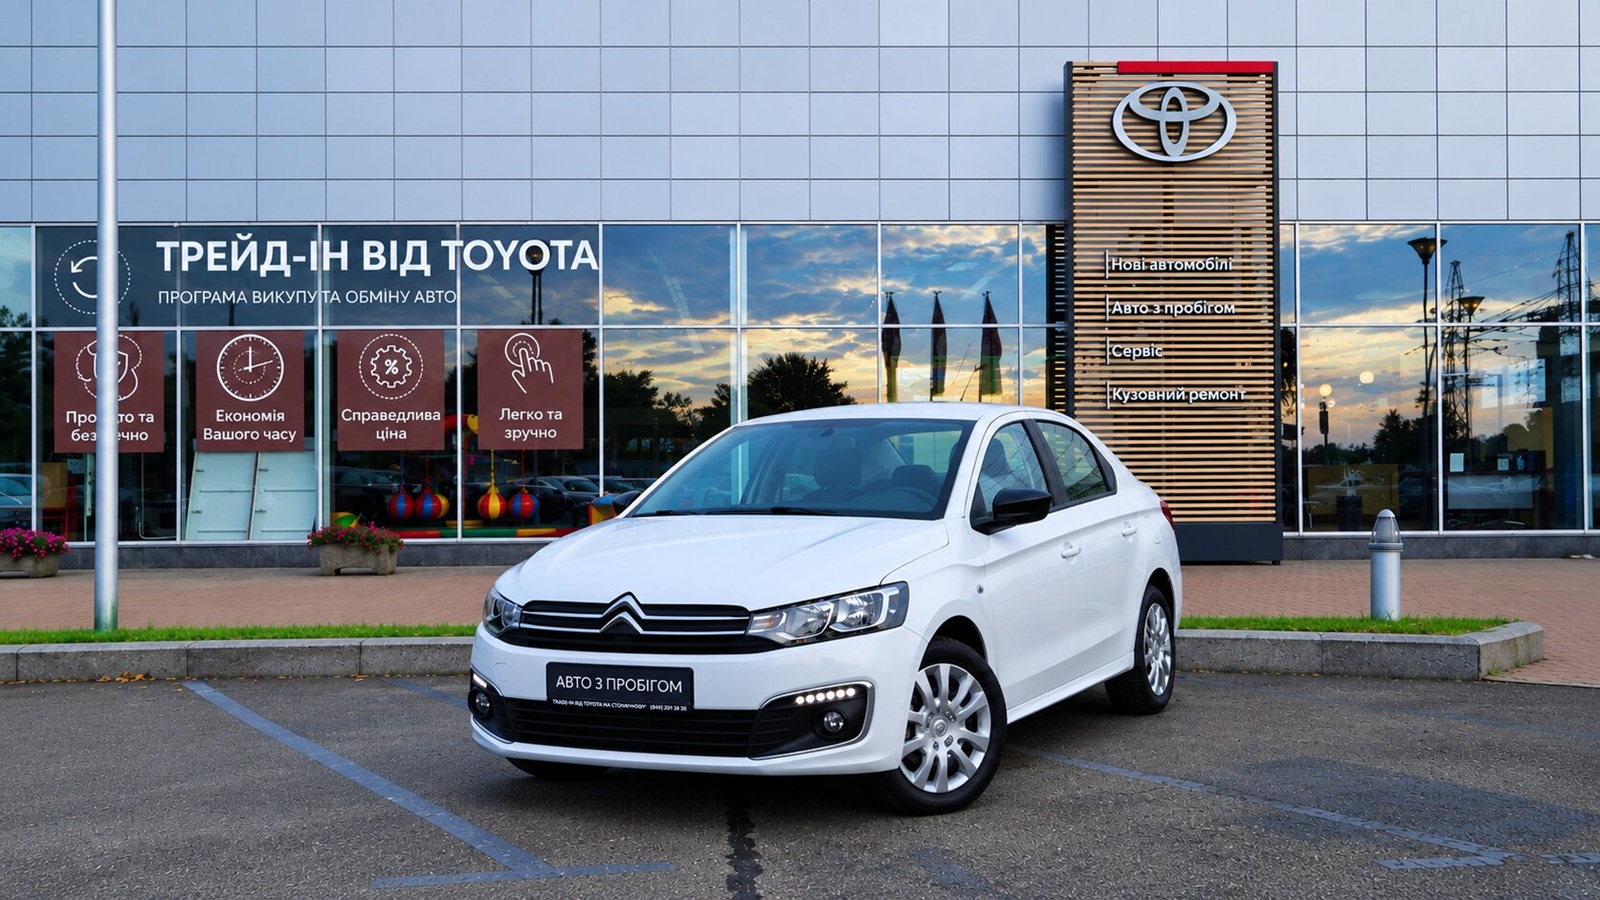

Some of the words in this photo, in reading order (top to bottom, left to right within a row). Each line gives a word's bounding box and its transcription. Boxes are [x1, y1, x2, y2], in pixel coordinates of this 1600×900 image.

[156, 233, 349, 277] ТРЕЙД-ІН
[363, 240, 431, 276] ВІД
[441, 239, 599, 271] TOYOTA
[1111, 257, 1145, 271] Нові
[1150, 257, 1232, 271] автомобілі
[158, 290, 248, 304] ПРОГРАМА
[252, 290, 317, 304] ВИКУПУ
[321, 290, 341, 304] ТА
[414, 290, 458, 304] АВТО
[1111, 301, 1149, 314] Авто
[1152, 304, 1162, 314] з
[1165, 301, 1235, 317] пробігом
[1111, 343, 1164, 360] Сервіс
[1112, 387, 1186, 403] Кузовний
[1189, 390, 1246, 403] ремонт
[138, 413, 155, 423] та
[216, 409, 285, 422] Економія
[341, 408, 441, 424] Справедлива
[499, 407, 543, 420] Легко
[547, 410, 563, 420] та
[71, 428, 149, 441] безчно
[203, 427, 260, 440] Вашого
[263, 430, 297, 443] часу
[376, 426, 407, 441] ціна
[504, 428, 557, 441] зручно
[556, 675, 592, 690] АВТО
[606, 677, 682, 693] ПРОБІГОМ
